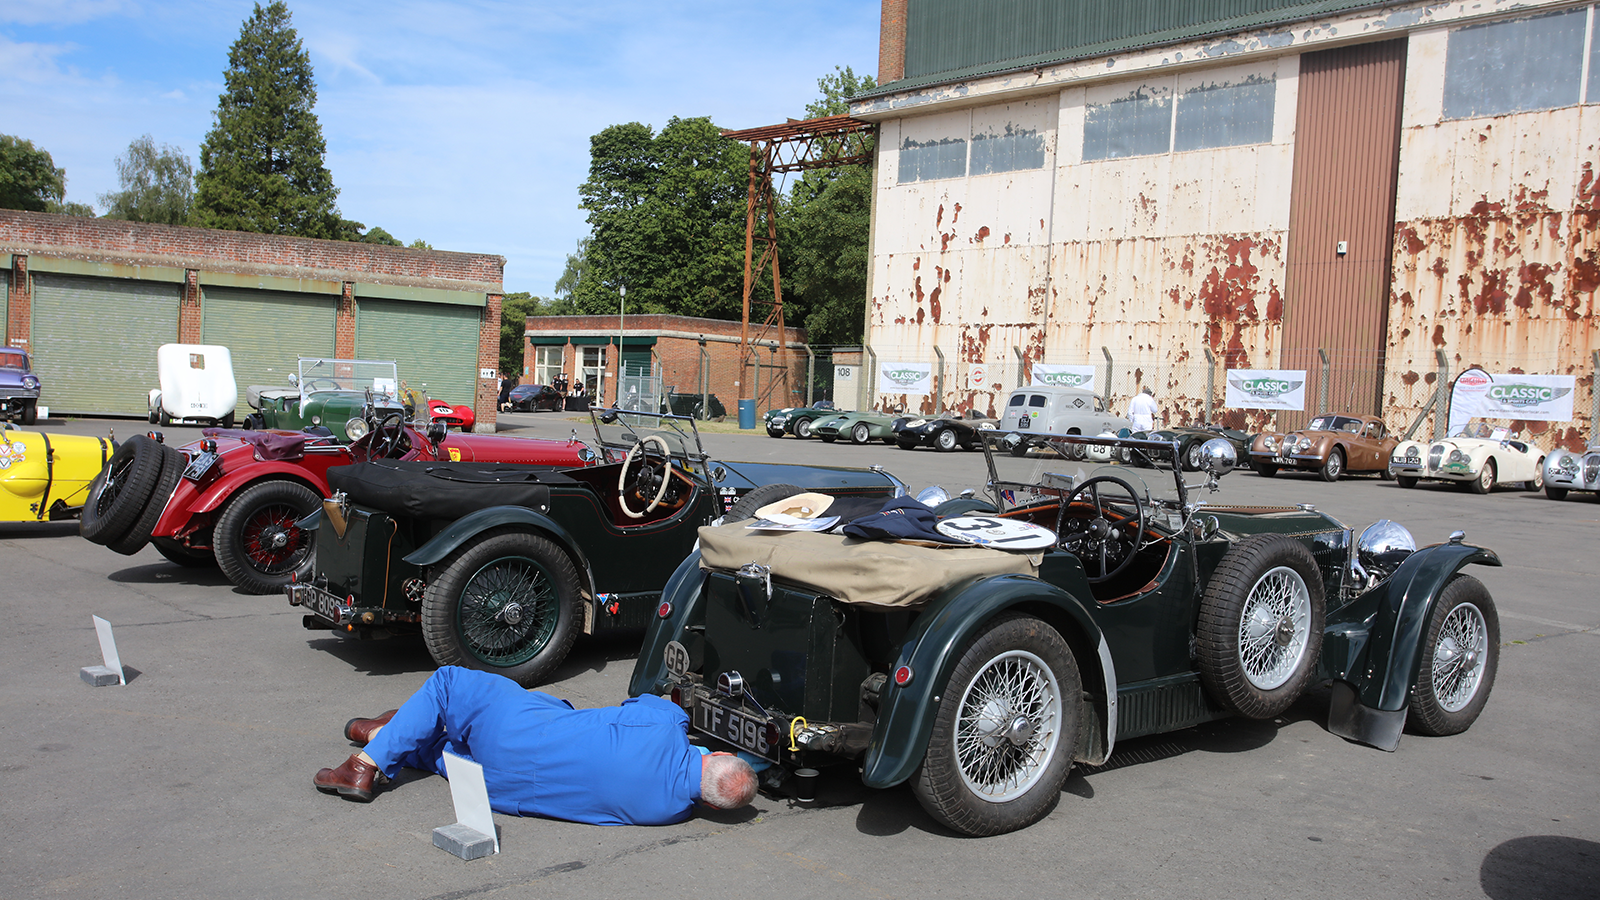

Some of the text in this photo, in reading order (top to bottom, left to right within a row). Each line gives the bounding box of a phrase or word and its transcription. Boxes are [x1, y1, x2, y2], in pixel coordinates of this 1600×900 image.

[837, 367, 851, 377] 108
[890, 371, 920, 381] CLASSIC
[1044, 374, 1082, 385] CLASSIC
[1242, 380, 1289, 393] CLASSIC
[1490, 386, 1552, 401] CLASSIC
[665, 644, 686, 674] GB
[701, 701, 724, 732] TF
